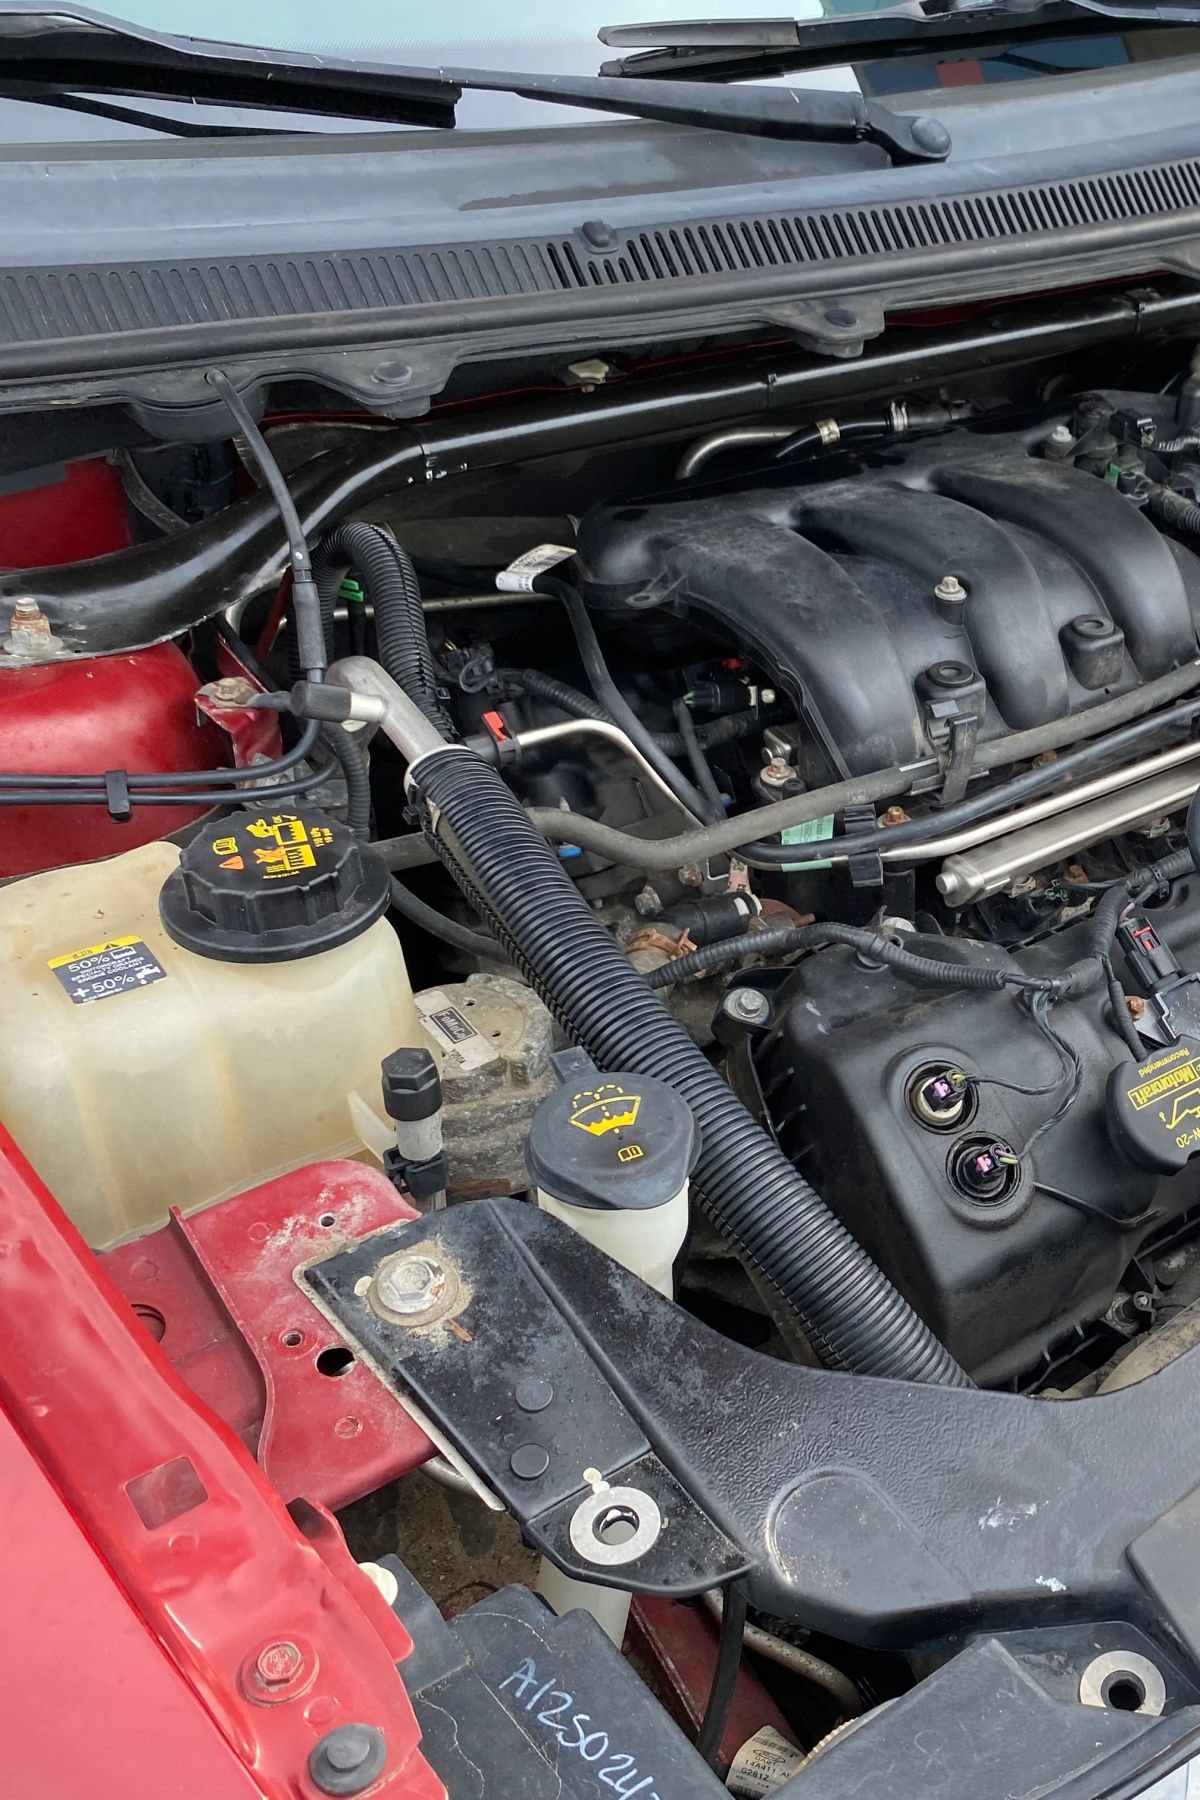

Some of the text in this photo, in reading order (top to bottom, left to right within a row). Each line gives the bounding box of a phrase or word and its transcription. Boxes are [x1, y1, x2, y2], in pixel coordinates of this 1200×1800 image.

[68, 955, 110, 972] 50%
[107, 960, 143, 974] COOLANT
[92, 973, 135, 993] 50%
[438, 1010, 466, 1039] FoMoCo
[1138, 1048, 1190, 1077] Recommended
